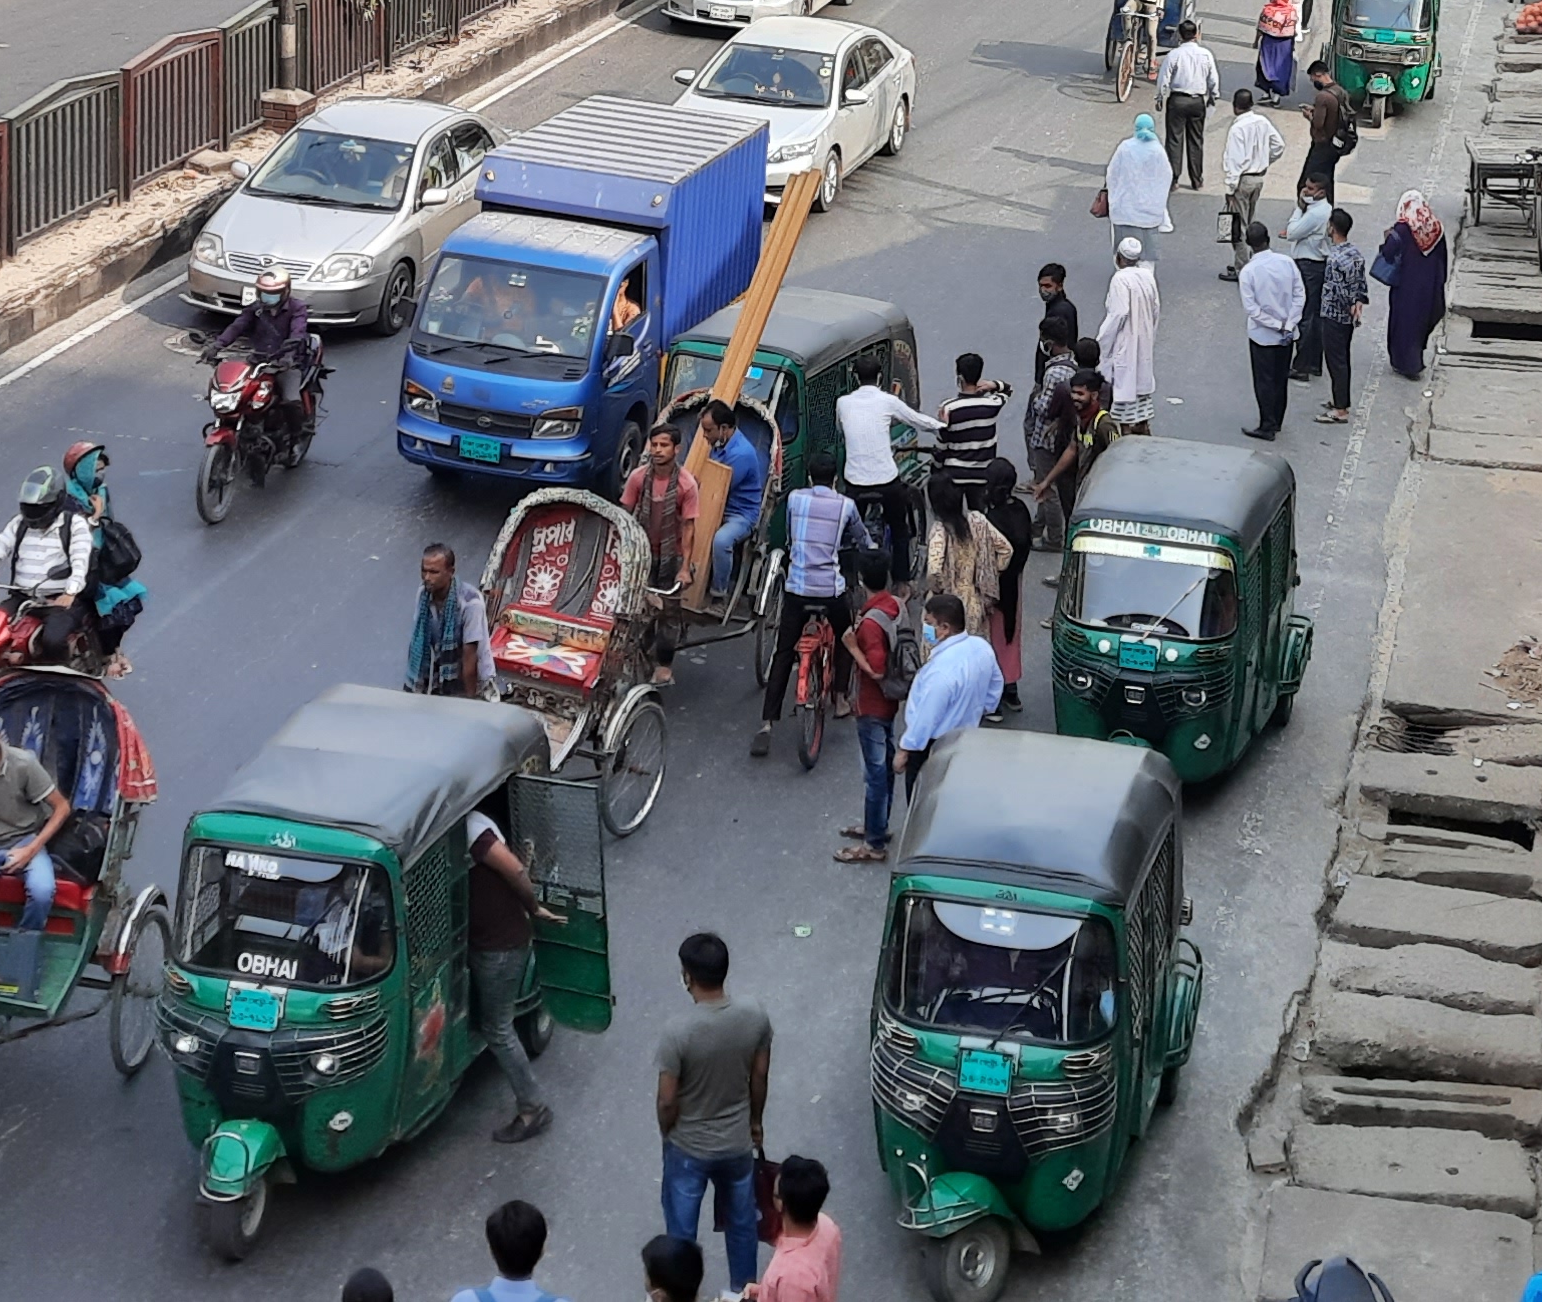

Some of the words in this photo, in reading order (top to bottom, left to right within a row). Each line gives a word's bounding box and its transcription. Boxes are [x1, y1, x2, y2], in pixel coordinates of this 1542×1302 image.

[1089, 518, 1141, 536] OBHAI
[1167, 526, 1214, 545] OBHAI
[237, 952, 298, 980] OBHAI
